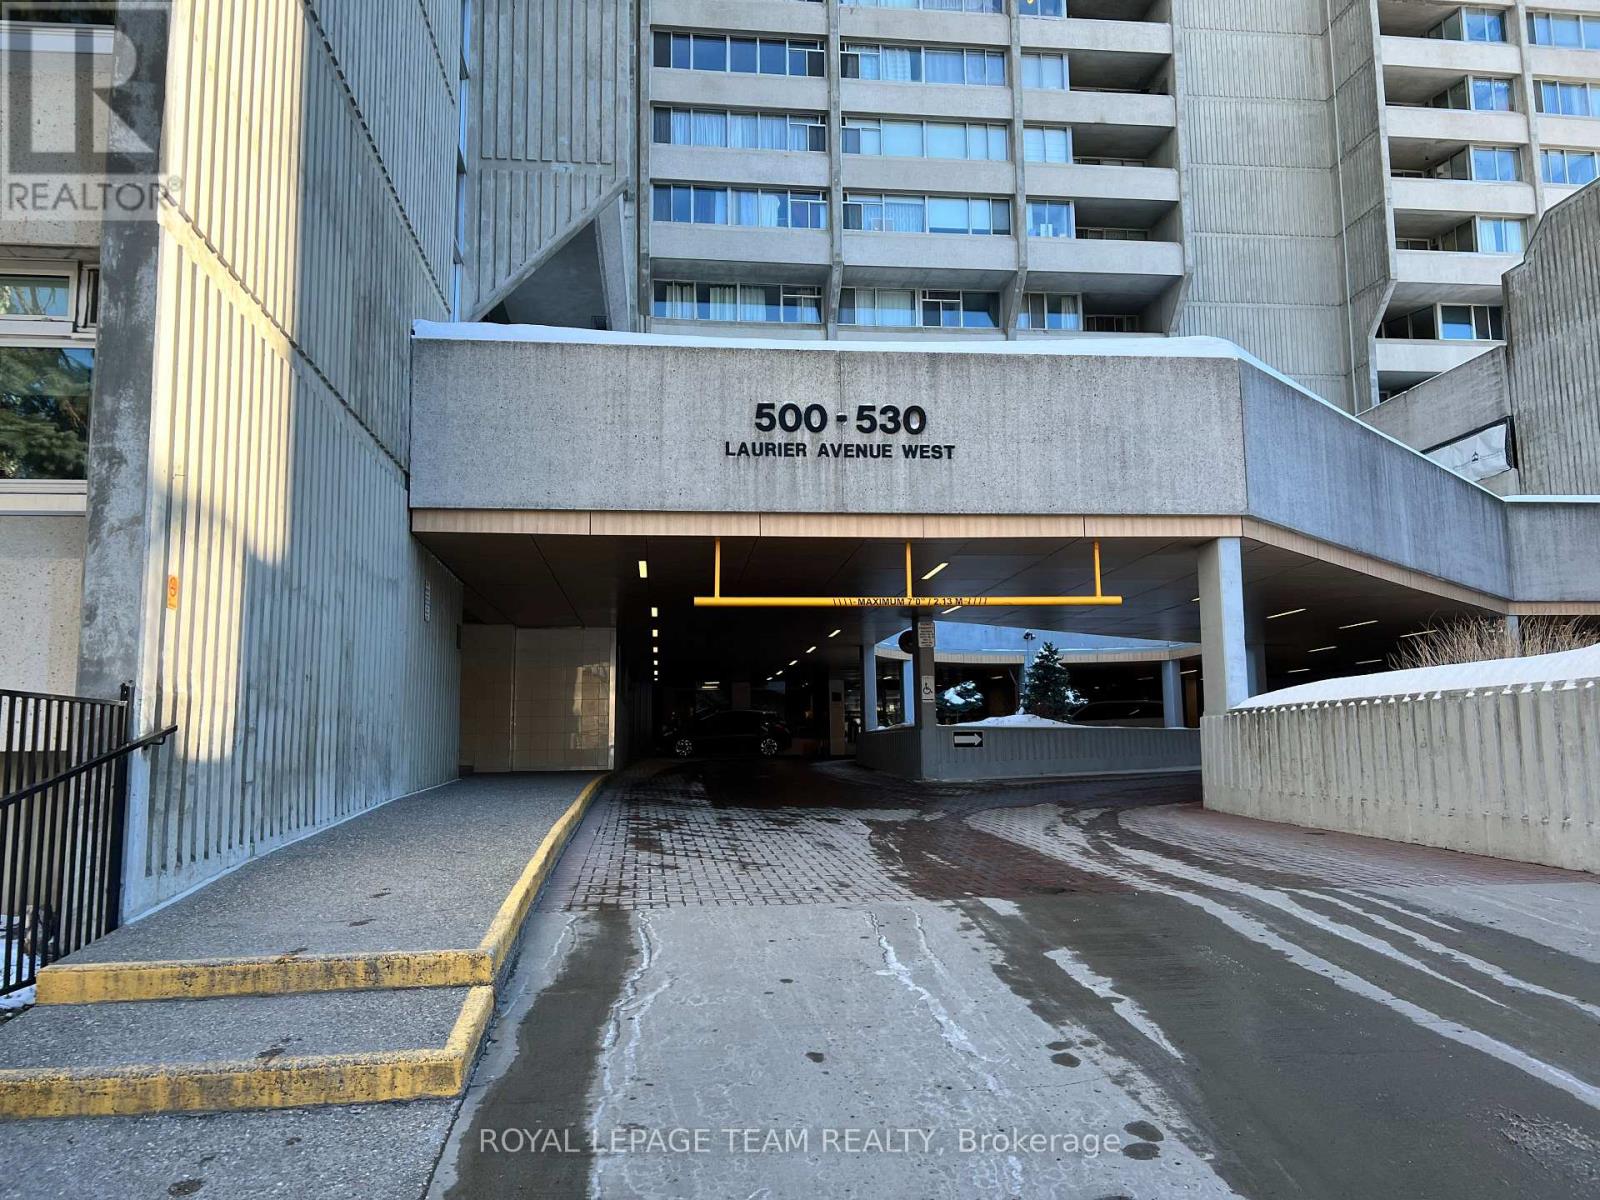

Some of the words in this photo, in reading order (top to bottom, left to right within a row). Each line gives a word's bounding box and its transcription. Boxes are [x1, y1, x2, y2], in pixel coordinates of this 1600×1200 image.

[754, 402, 828, 433] 500
[856, 404, 927, 435] 530
[725, 441, 807, 457] LAURIER
[817, 443, 893, 459] AVENUE
[902, 444, 956, 460] WEST
[857, 597, 905, 606] MAXIMUM
